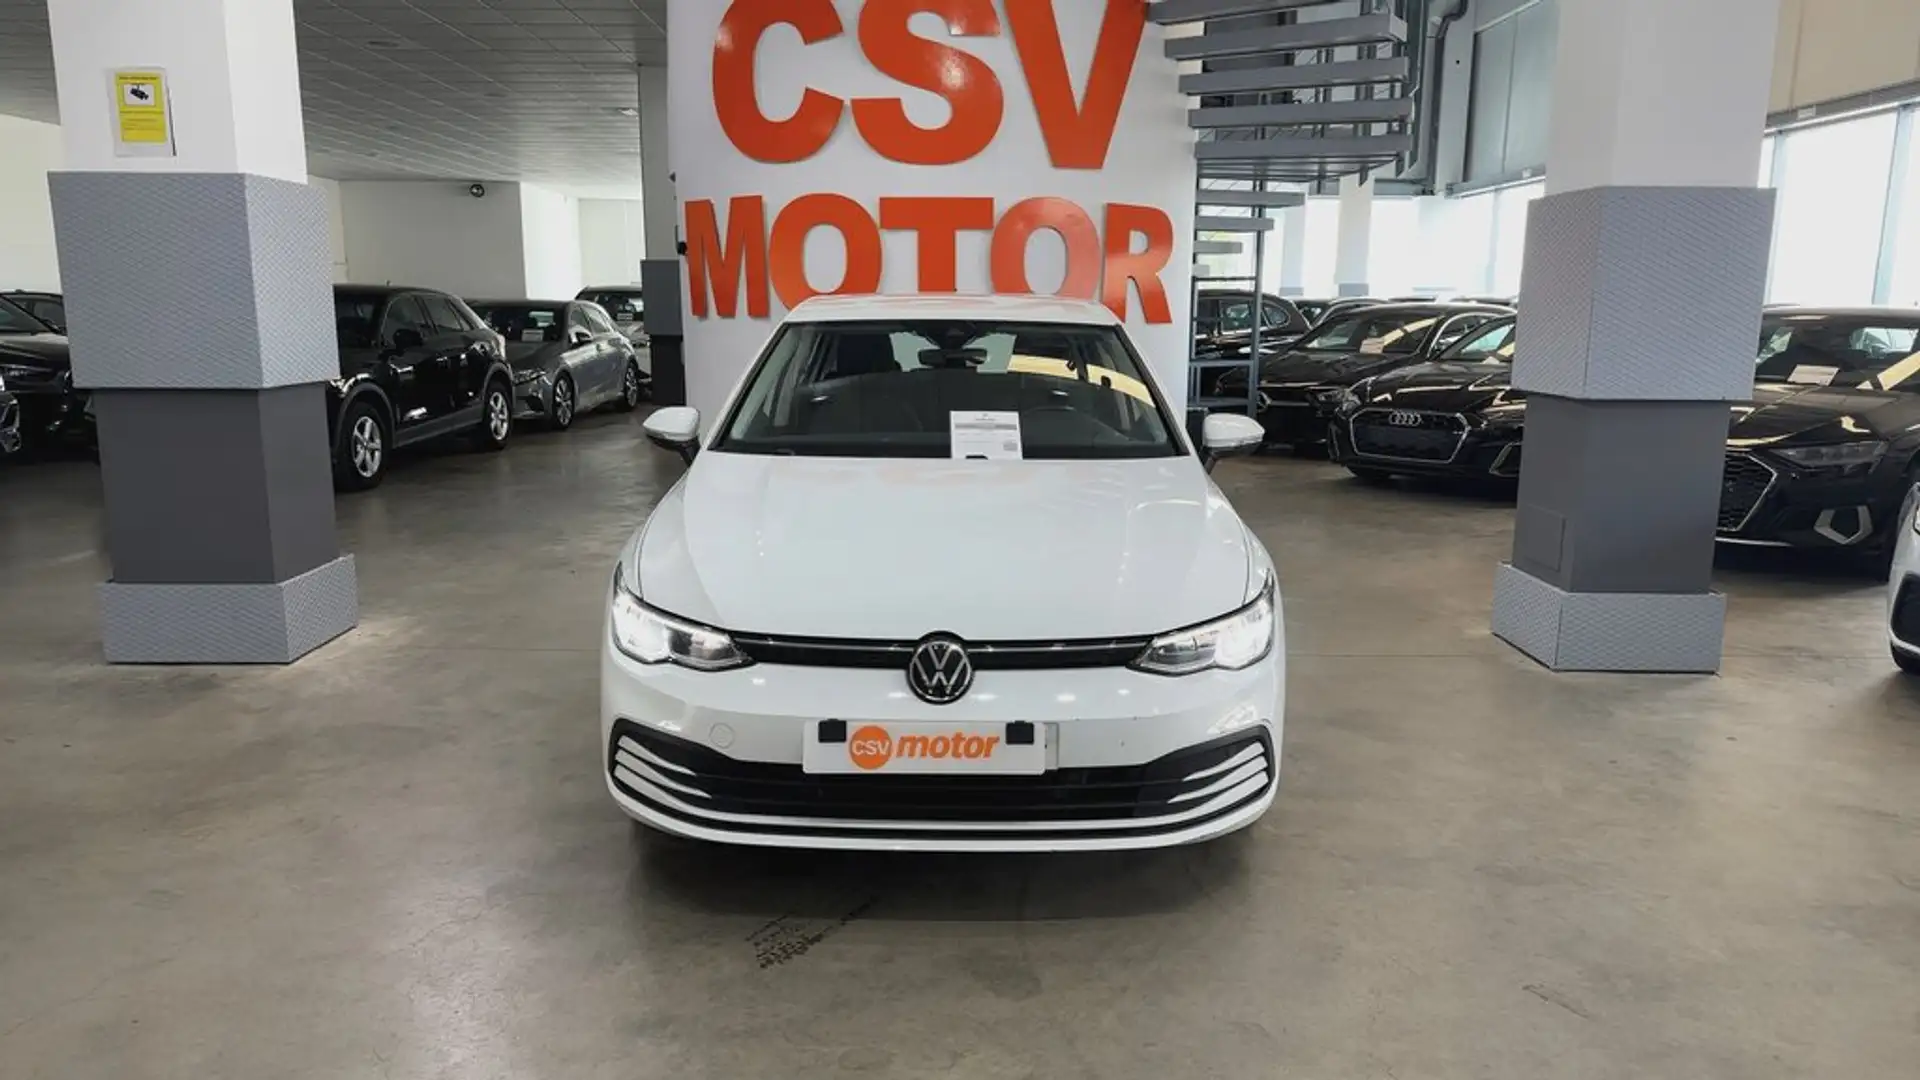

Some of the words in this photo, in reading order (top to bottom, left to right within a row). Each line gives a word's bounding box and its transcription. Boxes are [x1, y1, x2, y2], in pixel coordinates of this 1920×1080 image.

[712, 0, 1150, 171] CSV
[684, 192, 1174, 325] MOTOR
[851, 739, 891, 756] CSV
[895, 731, 1001, 759] motor
